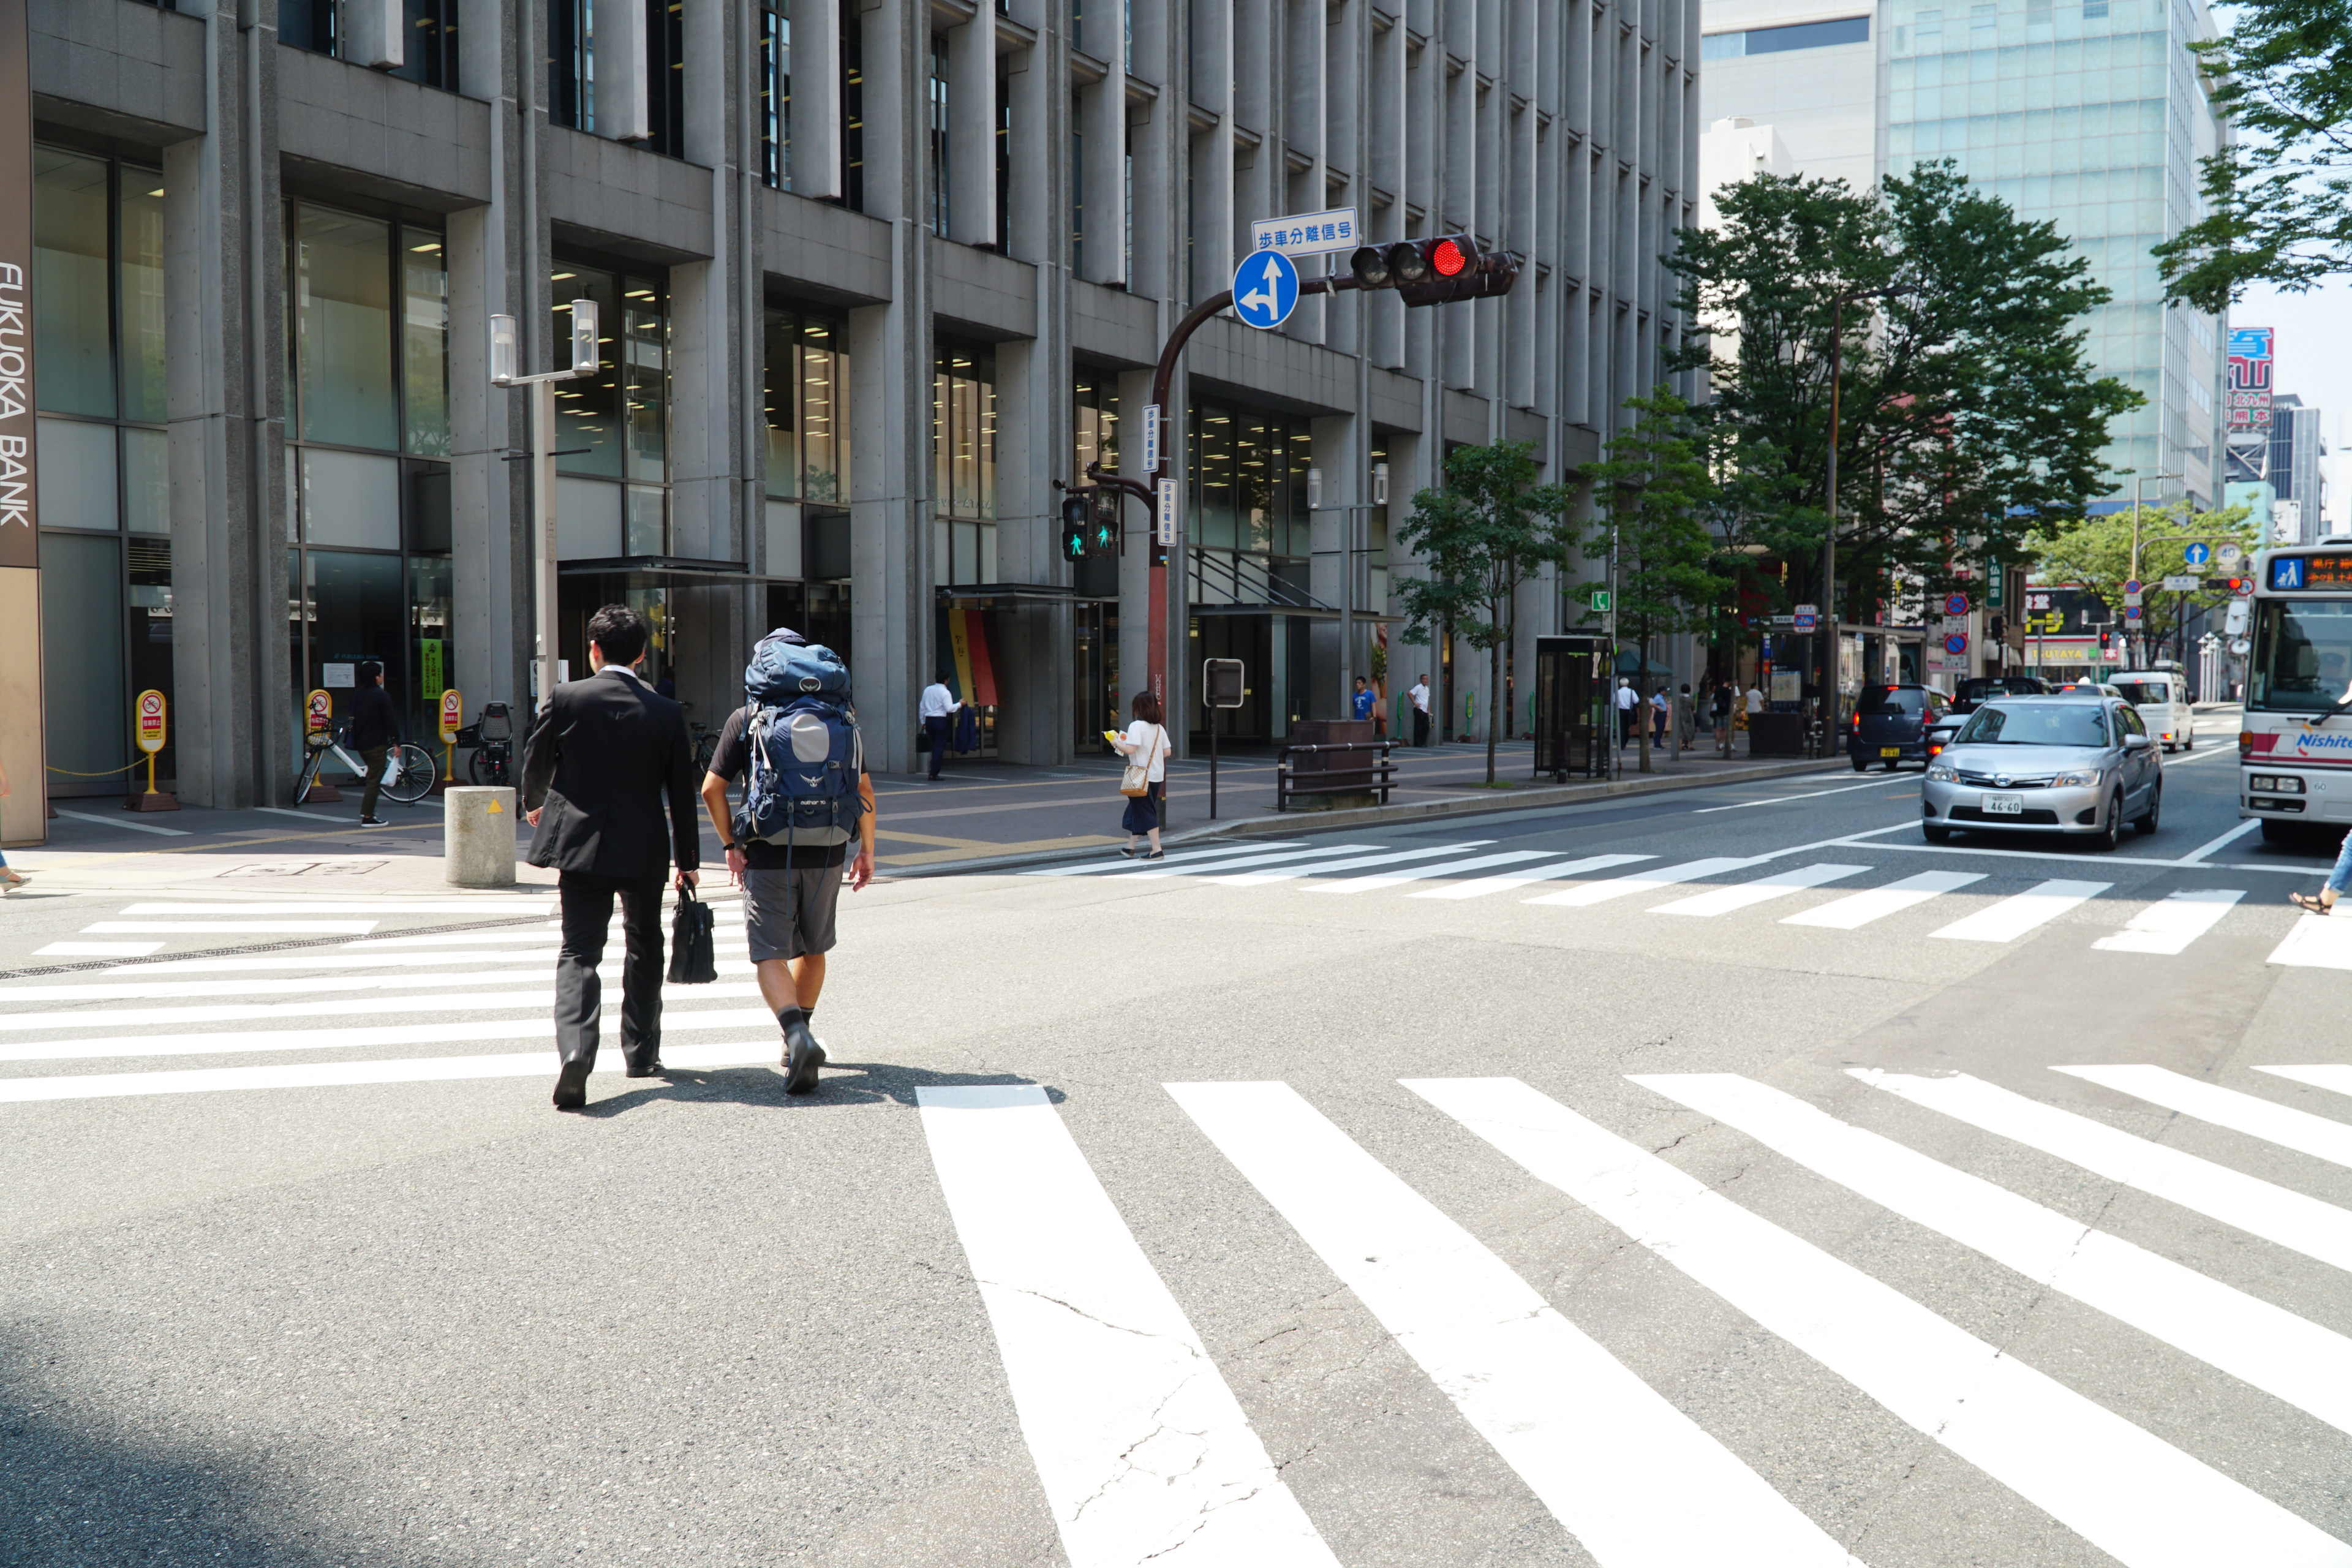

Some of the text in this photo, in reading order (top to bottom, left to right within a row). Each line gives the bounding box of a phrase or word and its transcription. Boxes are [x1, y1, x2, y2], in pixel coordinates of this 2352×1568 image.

[1259, 222, 1351, 249] 歩車分離信号
[0, 262, 28, 528] FUKUOKA BANK
[2234, 394, 2271, 408] 北九州
[2234, 409, 2269, 423] 熊本
[2221, 548, 2235, 558] 40
[2032, 649, 2082, 659] TUTAYA
[1991, 802, 2019, 812] 46-60
